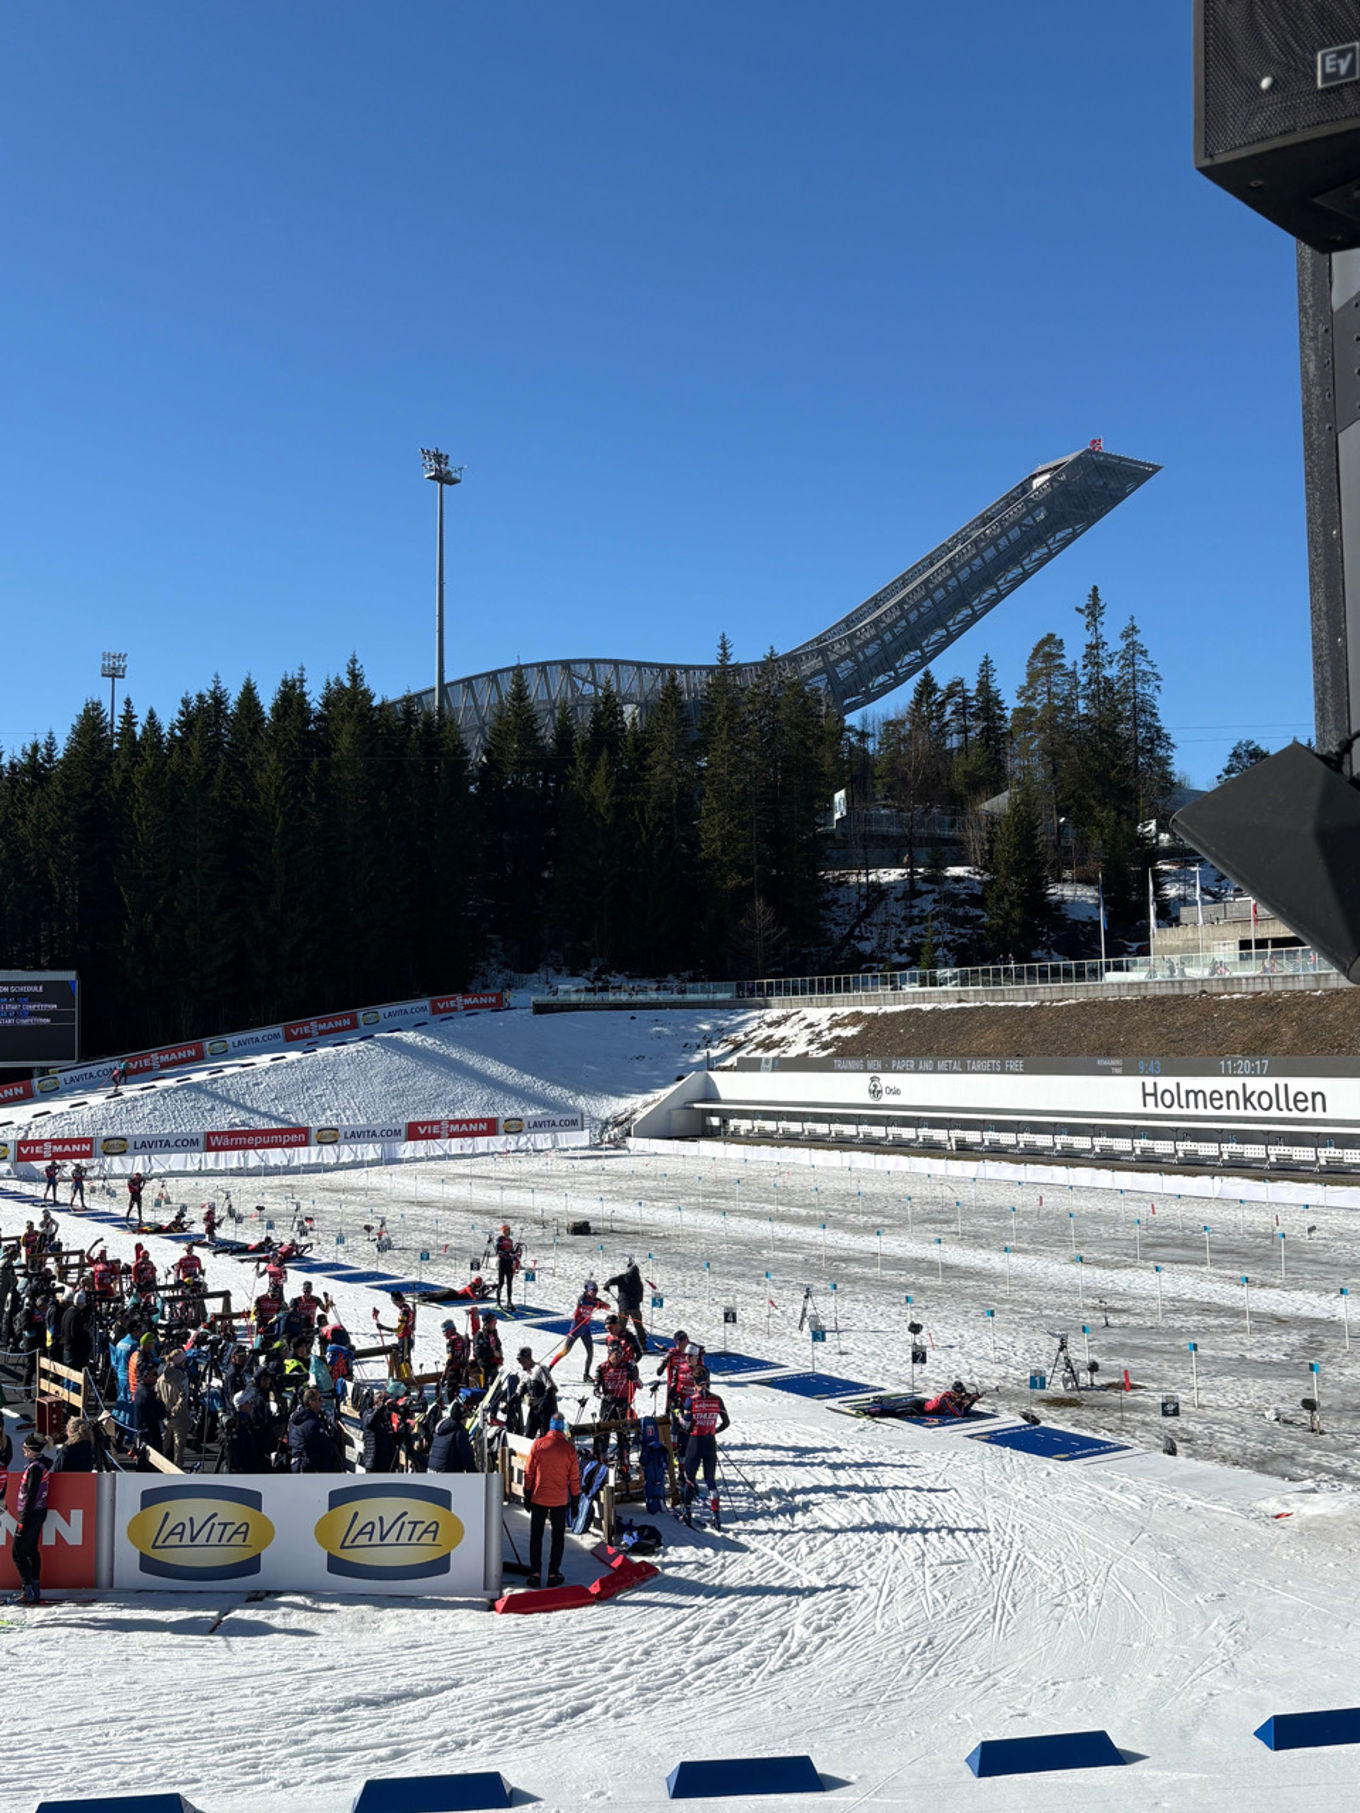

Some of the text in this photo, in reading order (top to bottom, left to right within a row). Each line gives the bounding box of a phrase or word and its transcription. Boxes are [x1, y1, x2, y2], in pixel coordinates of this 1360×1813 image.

[11, 985, 43, 993] SCHEDULE
[437, 996, 497, 1012] VIESSMANN
[383, 1005, 428, 1020] LAVITA.COM
[291, 1018, 350, 1037] VIESSMANN
[232, 1032, 281, 1049] LAVITA.COM
[834, 1059, 863, 1070] TRAINING
[867, 1059, 882, 1071] MEN
[892, 1060, 915, 1071] PAPER
[918, 1060, 934, 1071] AND
[937, 1060, 962, 1071] METAL
[967, 1060, 1001, 1071] TARGETS
[1005, 1060, 1024, 1071] FREE
[1138, 1060, 1161, 1074] 9:43
[1219, 1060, 1269, 1075] 11:20:17
[885, 1086, 901, 1096] Oslo
[1142, 1081, 1327, 1113] Holmenkollen
[417, 1121, 487, 1139] VIESSMANN
[528, 1118, 578, 1129] LAVITA.COM
[209, 1132, 305, 1146] Wärmepumpen
[344, 1129, 401, 1140] LAVITA.COM
[20, 1142, 90, 1158] VIESSMANN
[134, 1138, 200, 1150] LAVITA.COM
[816, 1331, 822, 1341] 3
[916, 1353, 922, 1363] 2
